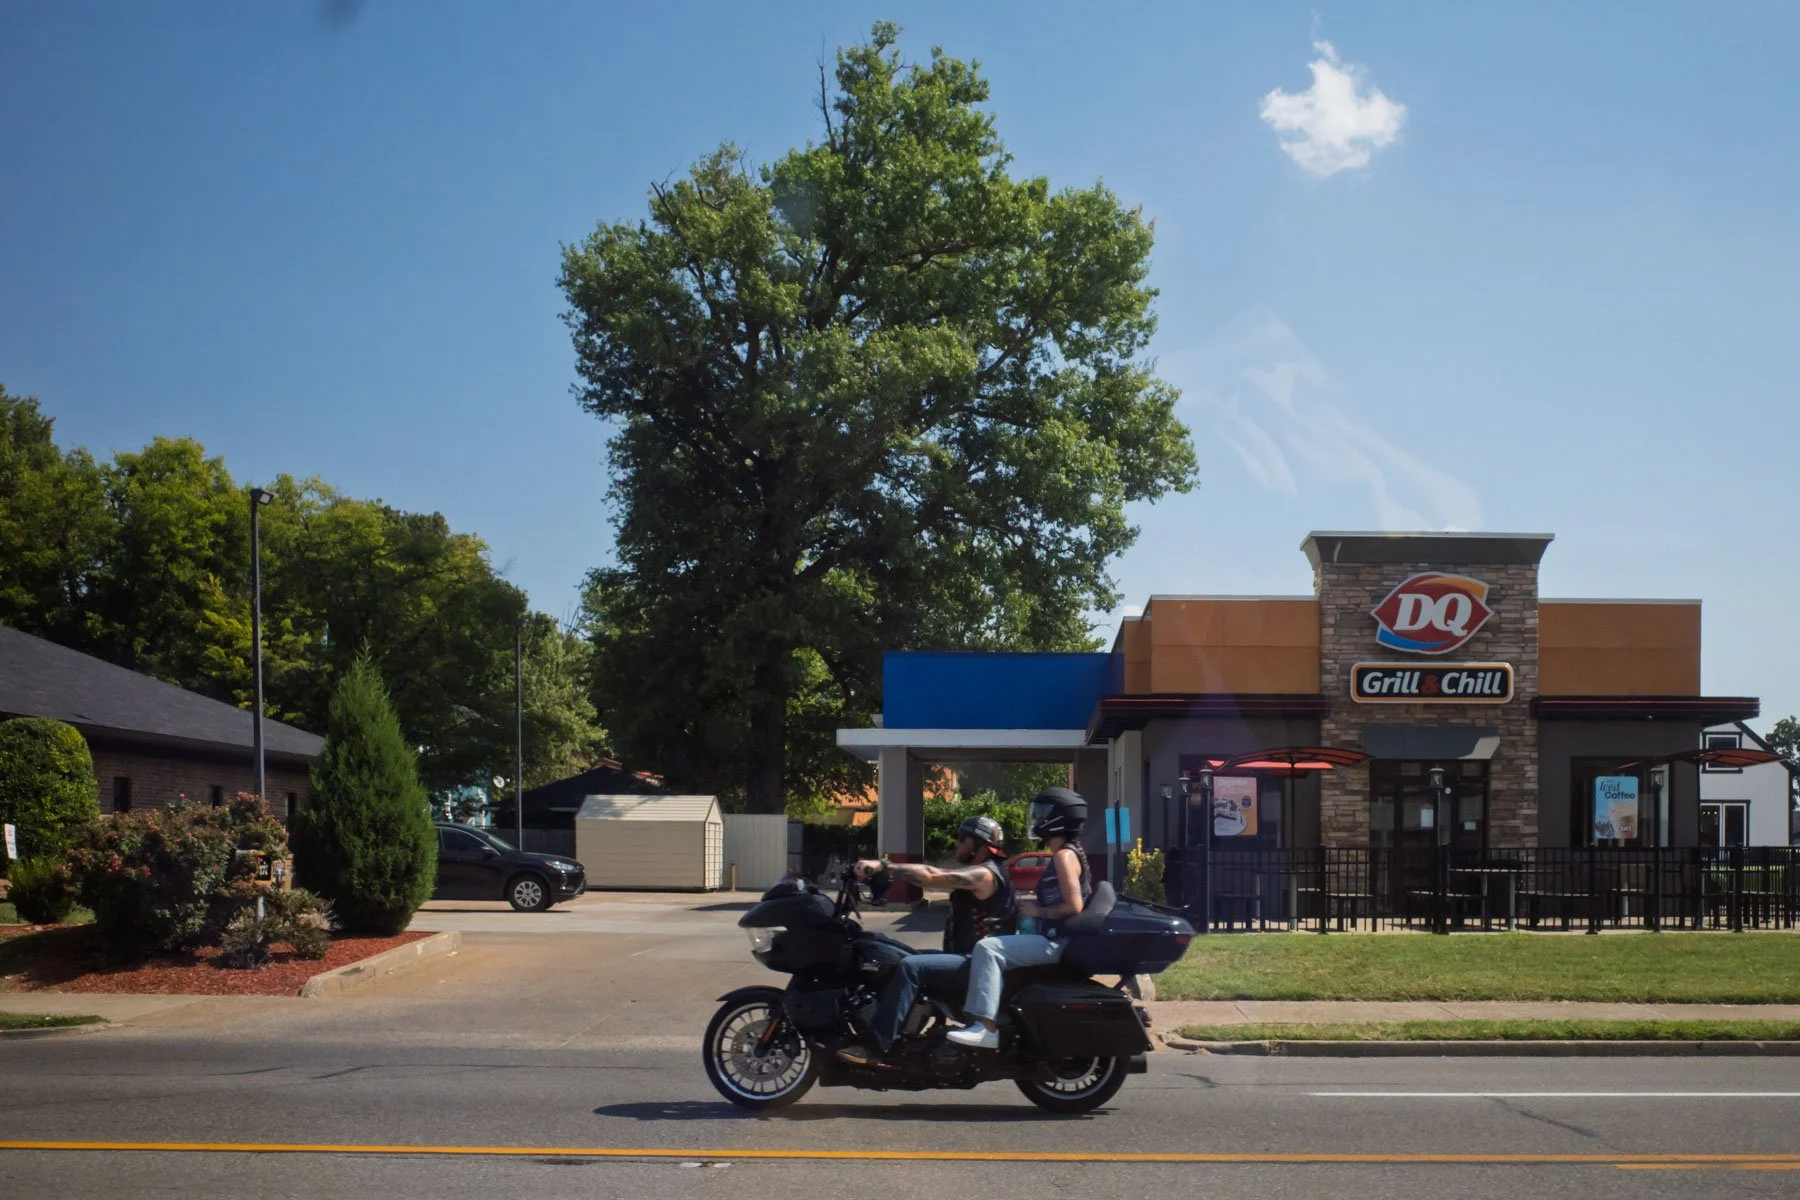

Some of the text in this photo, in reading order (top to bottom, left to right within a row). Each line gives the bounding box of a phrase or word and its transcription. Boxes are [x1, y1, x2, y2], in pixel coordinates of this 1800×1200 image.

[1392, 593, 1472, 636] DQ
[1362, 671, 1502, 694] Grill & Chill
[1599, 781, 1621, 792] Iced
[1604, 791, 1636, 800] Coffee
